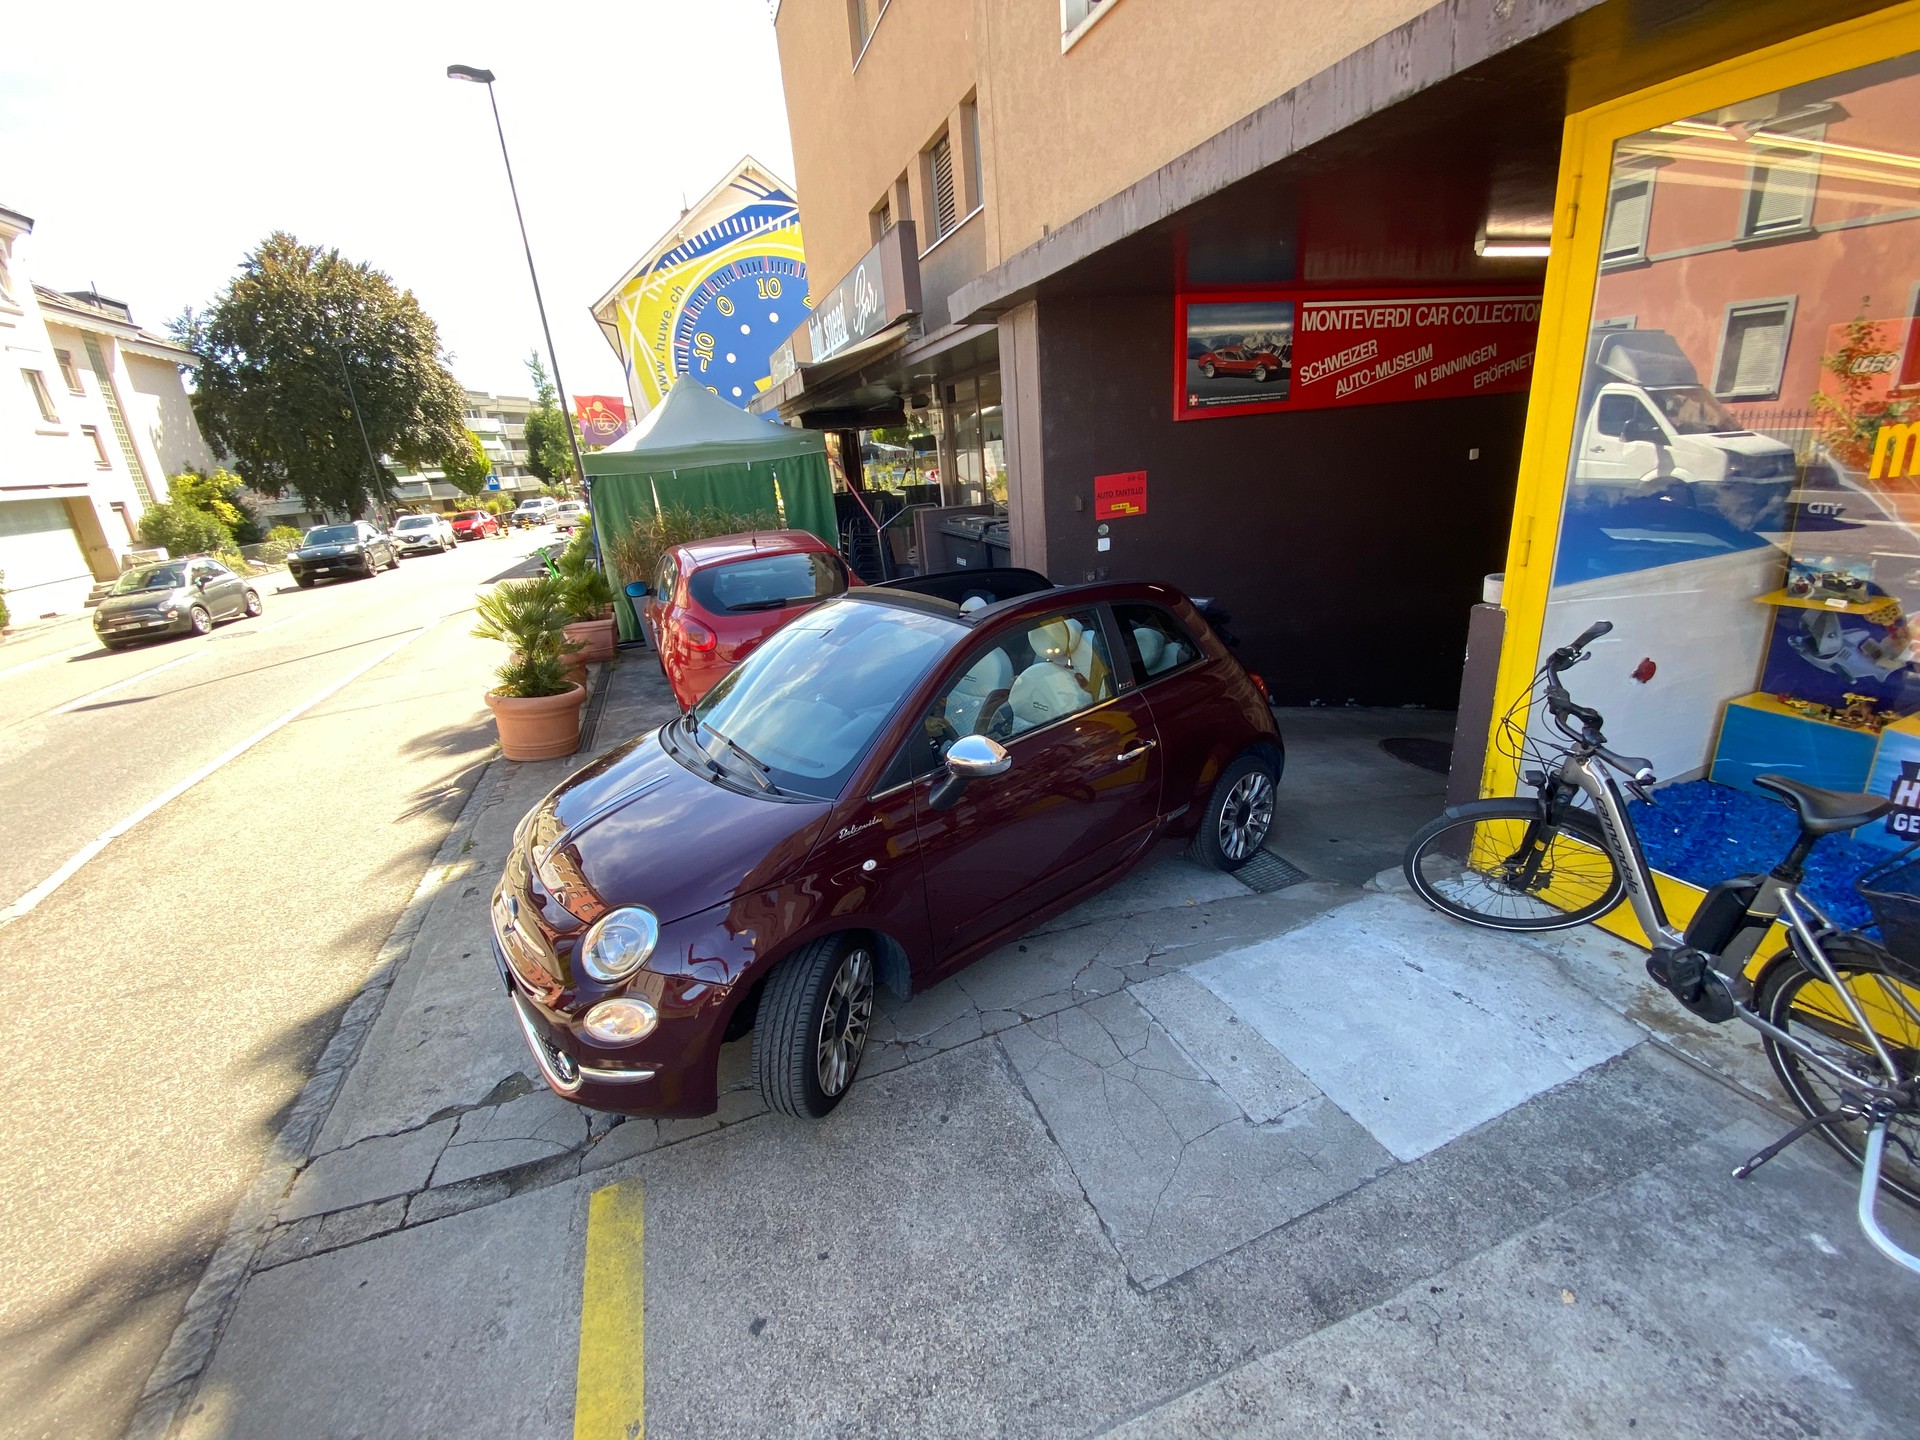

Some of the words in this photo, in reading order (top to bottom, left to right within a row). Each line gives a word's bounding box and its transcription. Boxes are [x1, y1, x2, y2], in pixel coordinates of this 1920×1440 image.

[757, 276, 782, 299] 10
[716, 295, 735, 317] 0
[1301, 308, 1411, 331] MONTEVERDI
[1415, 306, 1449, 327] CAR
[1299, 339, 1378, 384] SCHWEIZER
[1335, 343, 1433, 397] AUTO-MUSEUM
[1414, 371, 1428, 389] IN
[1430, 342, 1498, 383] BINNINGEN
[1473, 351, 1535, 389] ERÖFFNET
[1849, 353, 1899, 375] LEGO
[1097, 490, 1114, 500] AUTO
[1115, 486, 1144, 498] TANTILLO
[1807, 502, 1843, 515] CITY
[1595, 796, 1639, 895] cannondale
